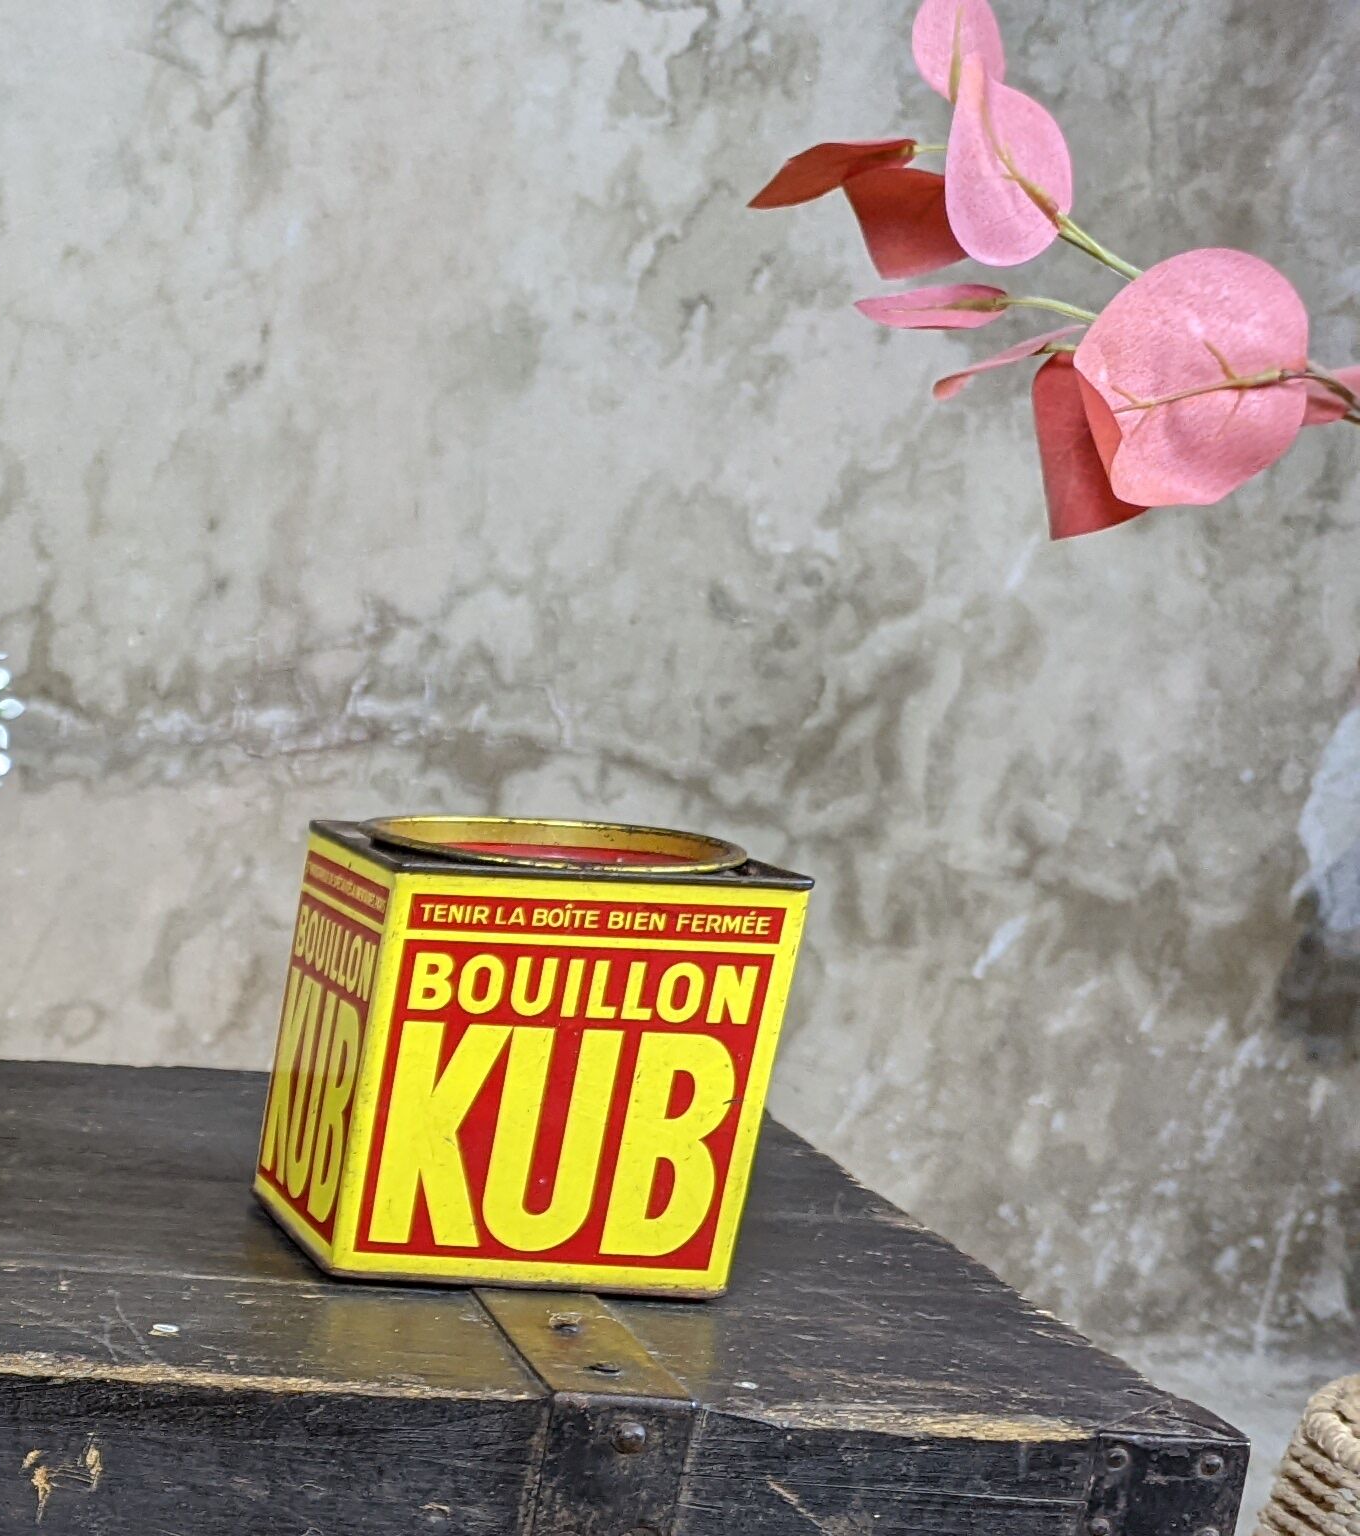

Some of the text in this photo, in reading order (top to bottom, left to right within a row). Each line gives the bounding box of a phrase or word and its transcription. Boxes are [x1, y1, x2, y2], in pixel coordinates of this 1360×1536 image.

[294, 903, 377, 1002] BOUILLON
[420, 902, 772, 936] TENIR LA BOÎTE BIEN FERMÉE
[407, 951, 760, 1025] BOUILLON
[261, 965, 361, 1225] KUB
[367, 1019, 736, 1258] KUB
